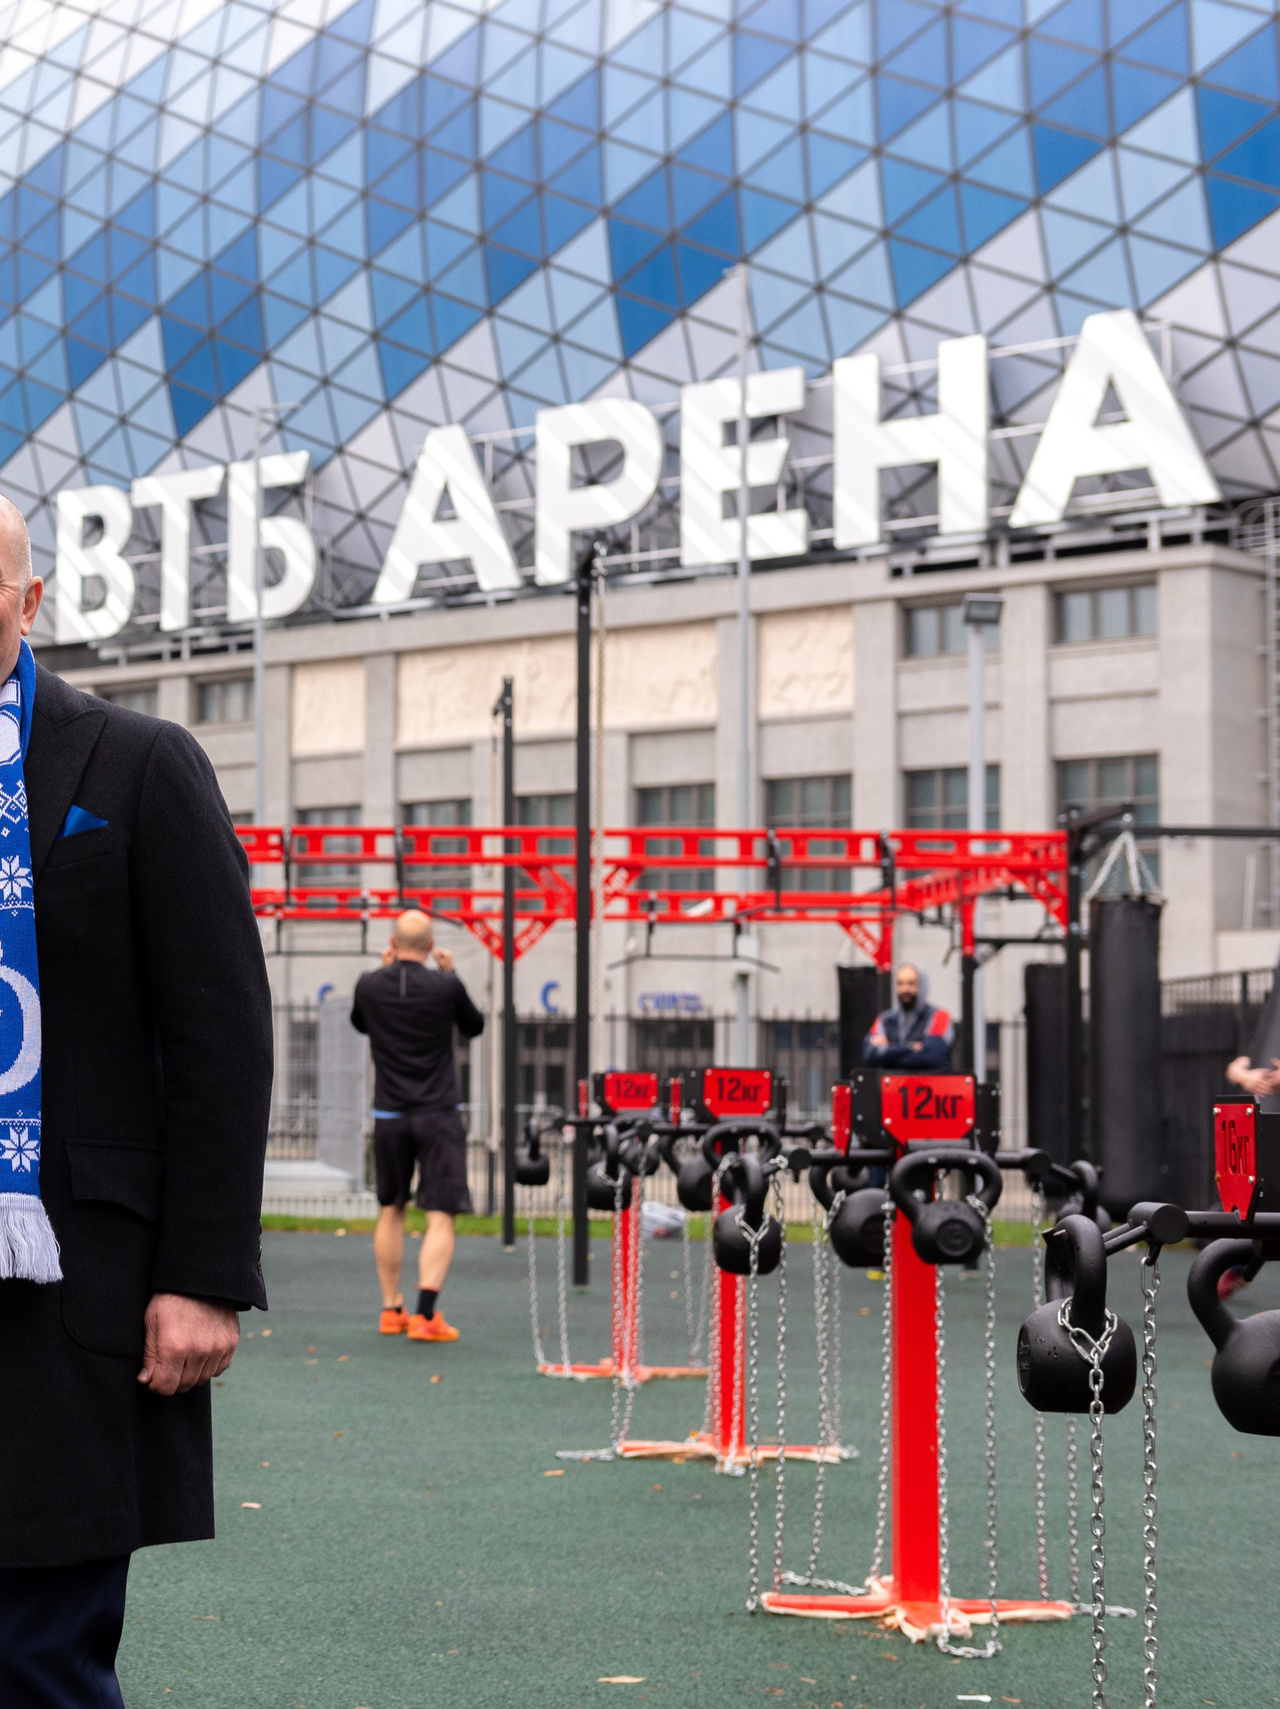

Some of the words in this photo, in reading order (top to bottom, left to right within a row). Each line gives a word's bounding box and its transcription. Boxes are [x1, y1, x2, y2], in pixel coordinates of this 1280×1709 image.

[55, 450, 314, 645] ВТБ
[372, 309, 1222, 606] АРЕНА
[615, 1078, 649, 1099] 12кг
[716, 1076, 763, 1103] 12кг
[898, 1086, 963, 1120] 12кг
[1222, 1120, 1250, 1175] 16кг
